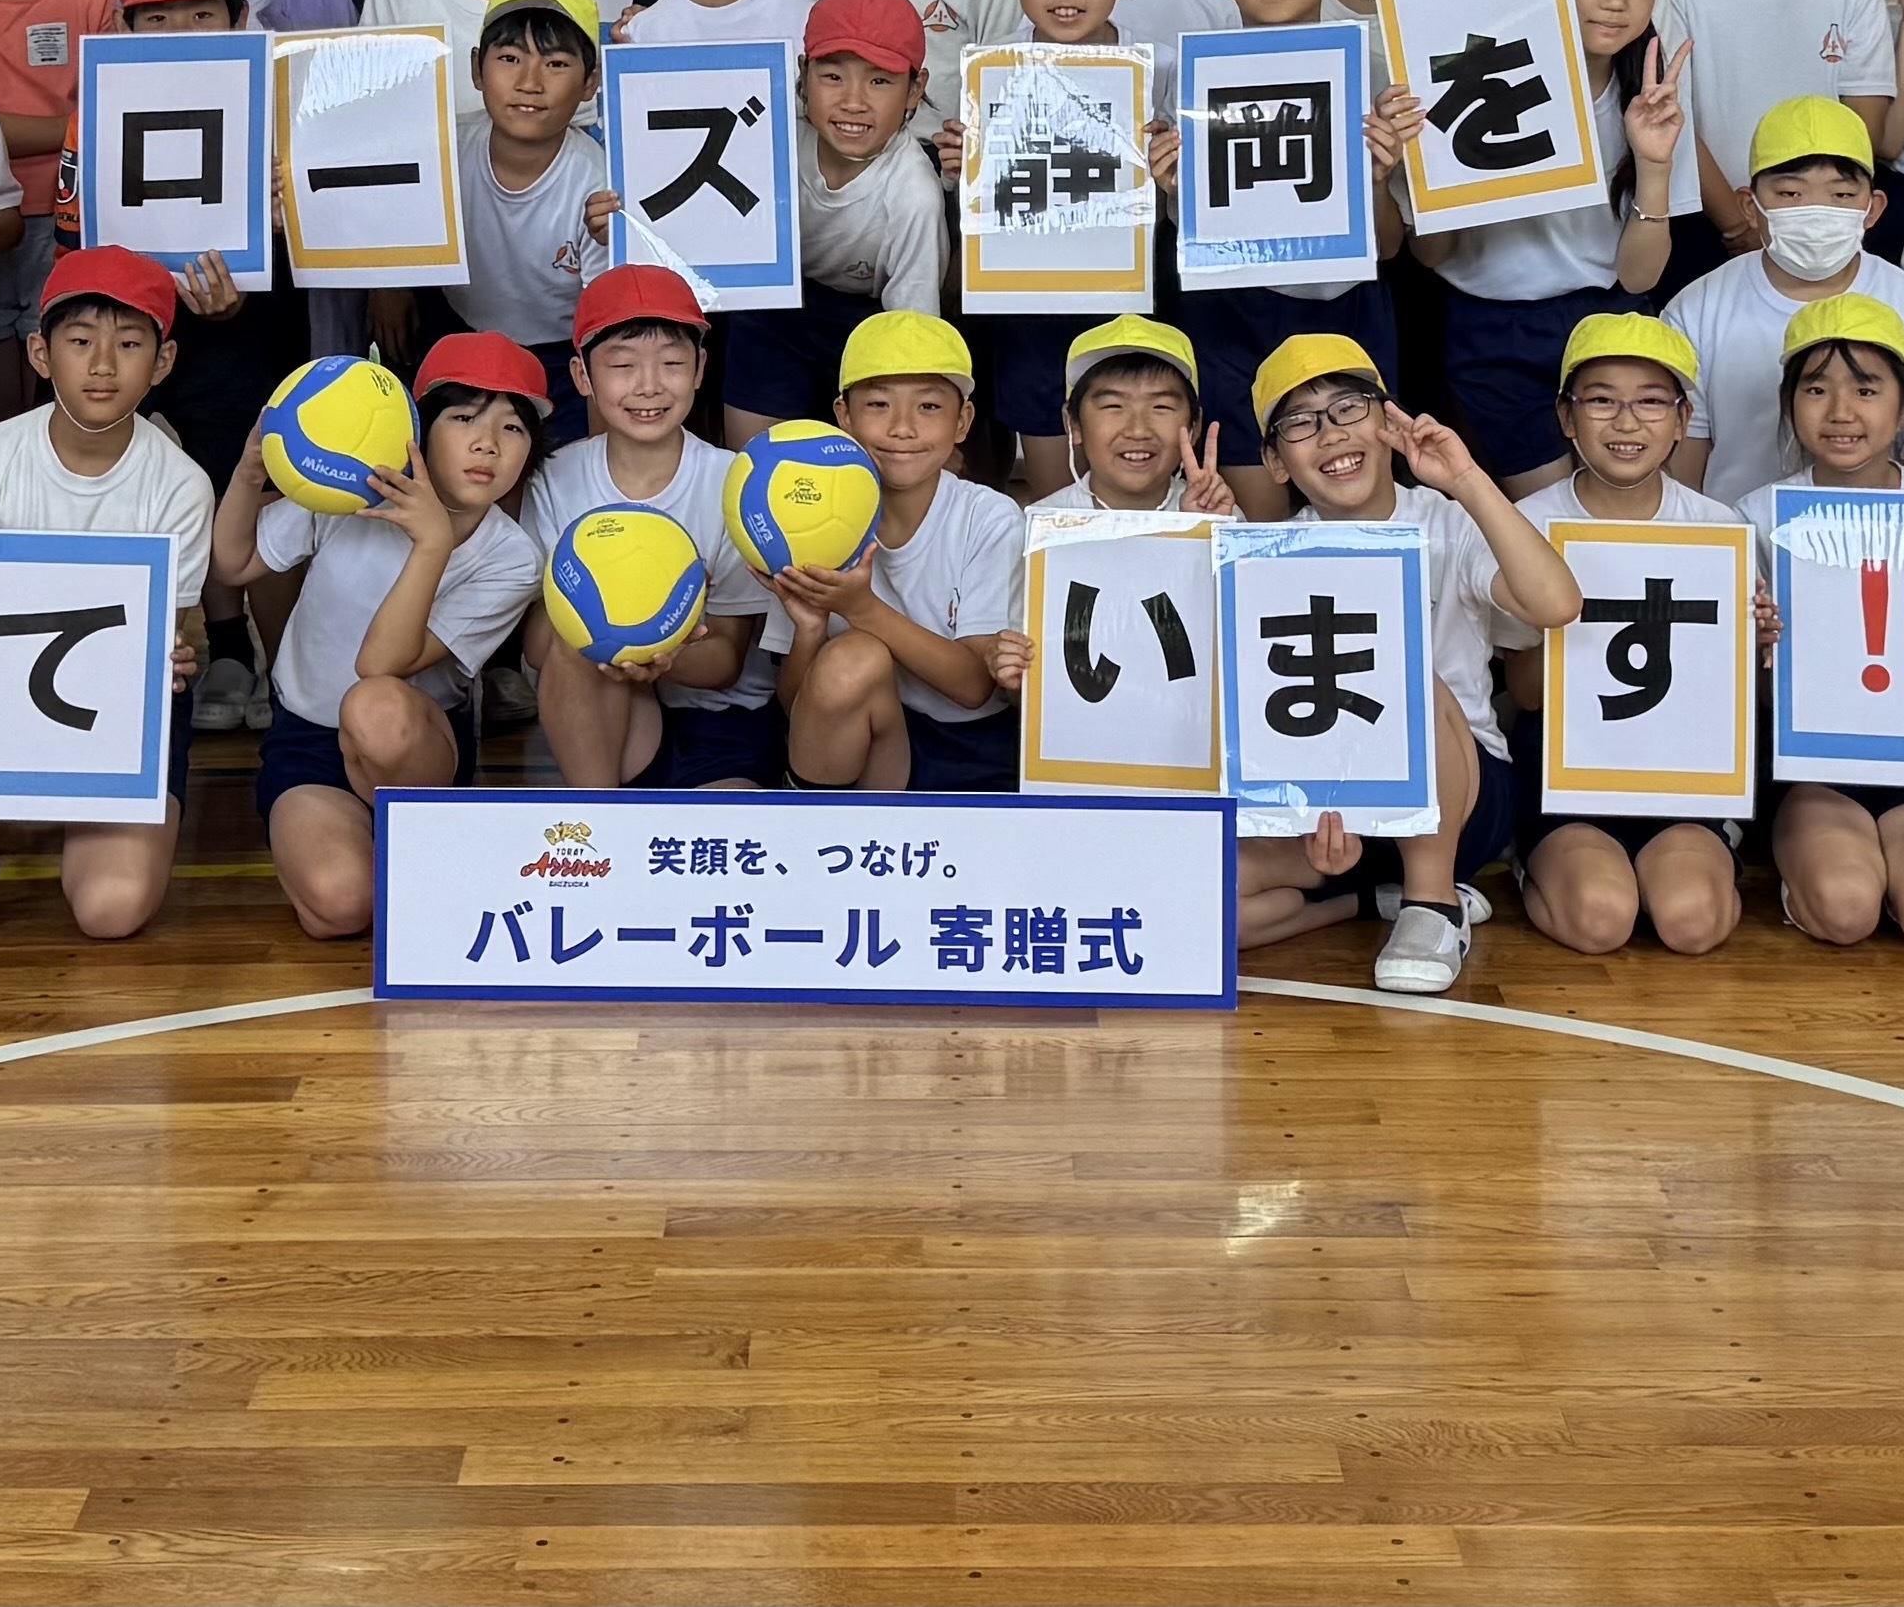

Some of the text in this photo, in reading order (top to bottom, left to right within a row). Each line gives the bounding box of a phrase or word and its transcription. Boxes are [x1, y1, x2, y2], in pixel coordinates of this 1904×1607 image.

[639, 95, 767, 222] ズ
[1207, 80, 1333, 209] 岡
[1428, 33, 1557, 170] を
[1062, 580, 1197, 704] い
[1258, 594, 1386, 738] ま
[1580, 577, 1720, 722] す
[520, 856, 612, 879] Arrows
[555, 847, 585, 856] TORAY
[465, 899, 1145, 976] バレーボール 寄贈式
